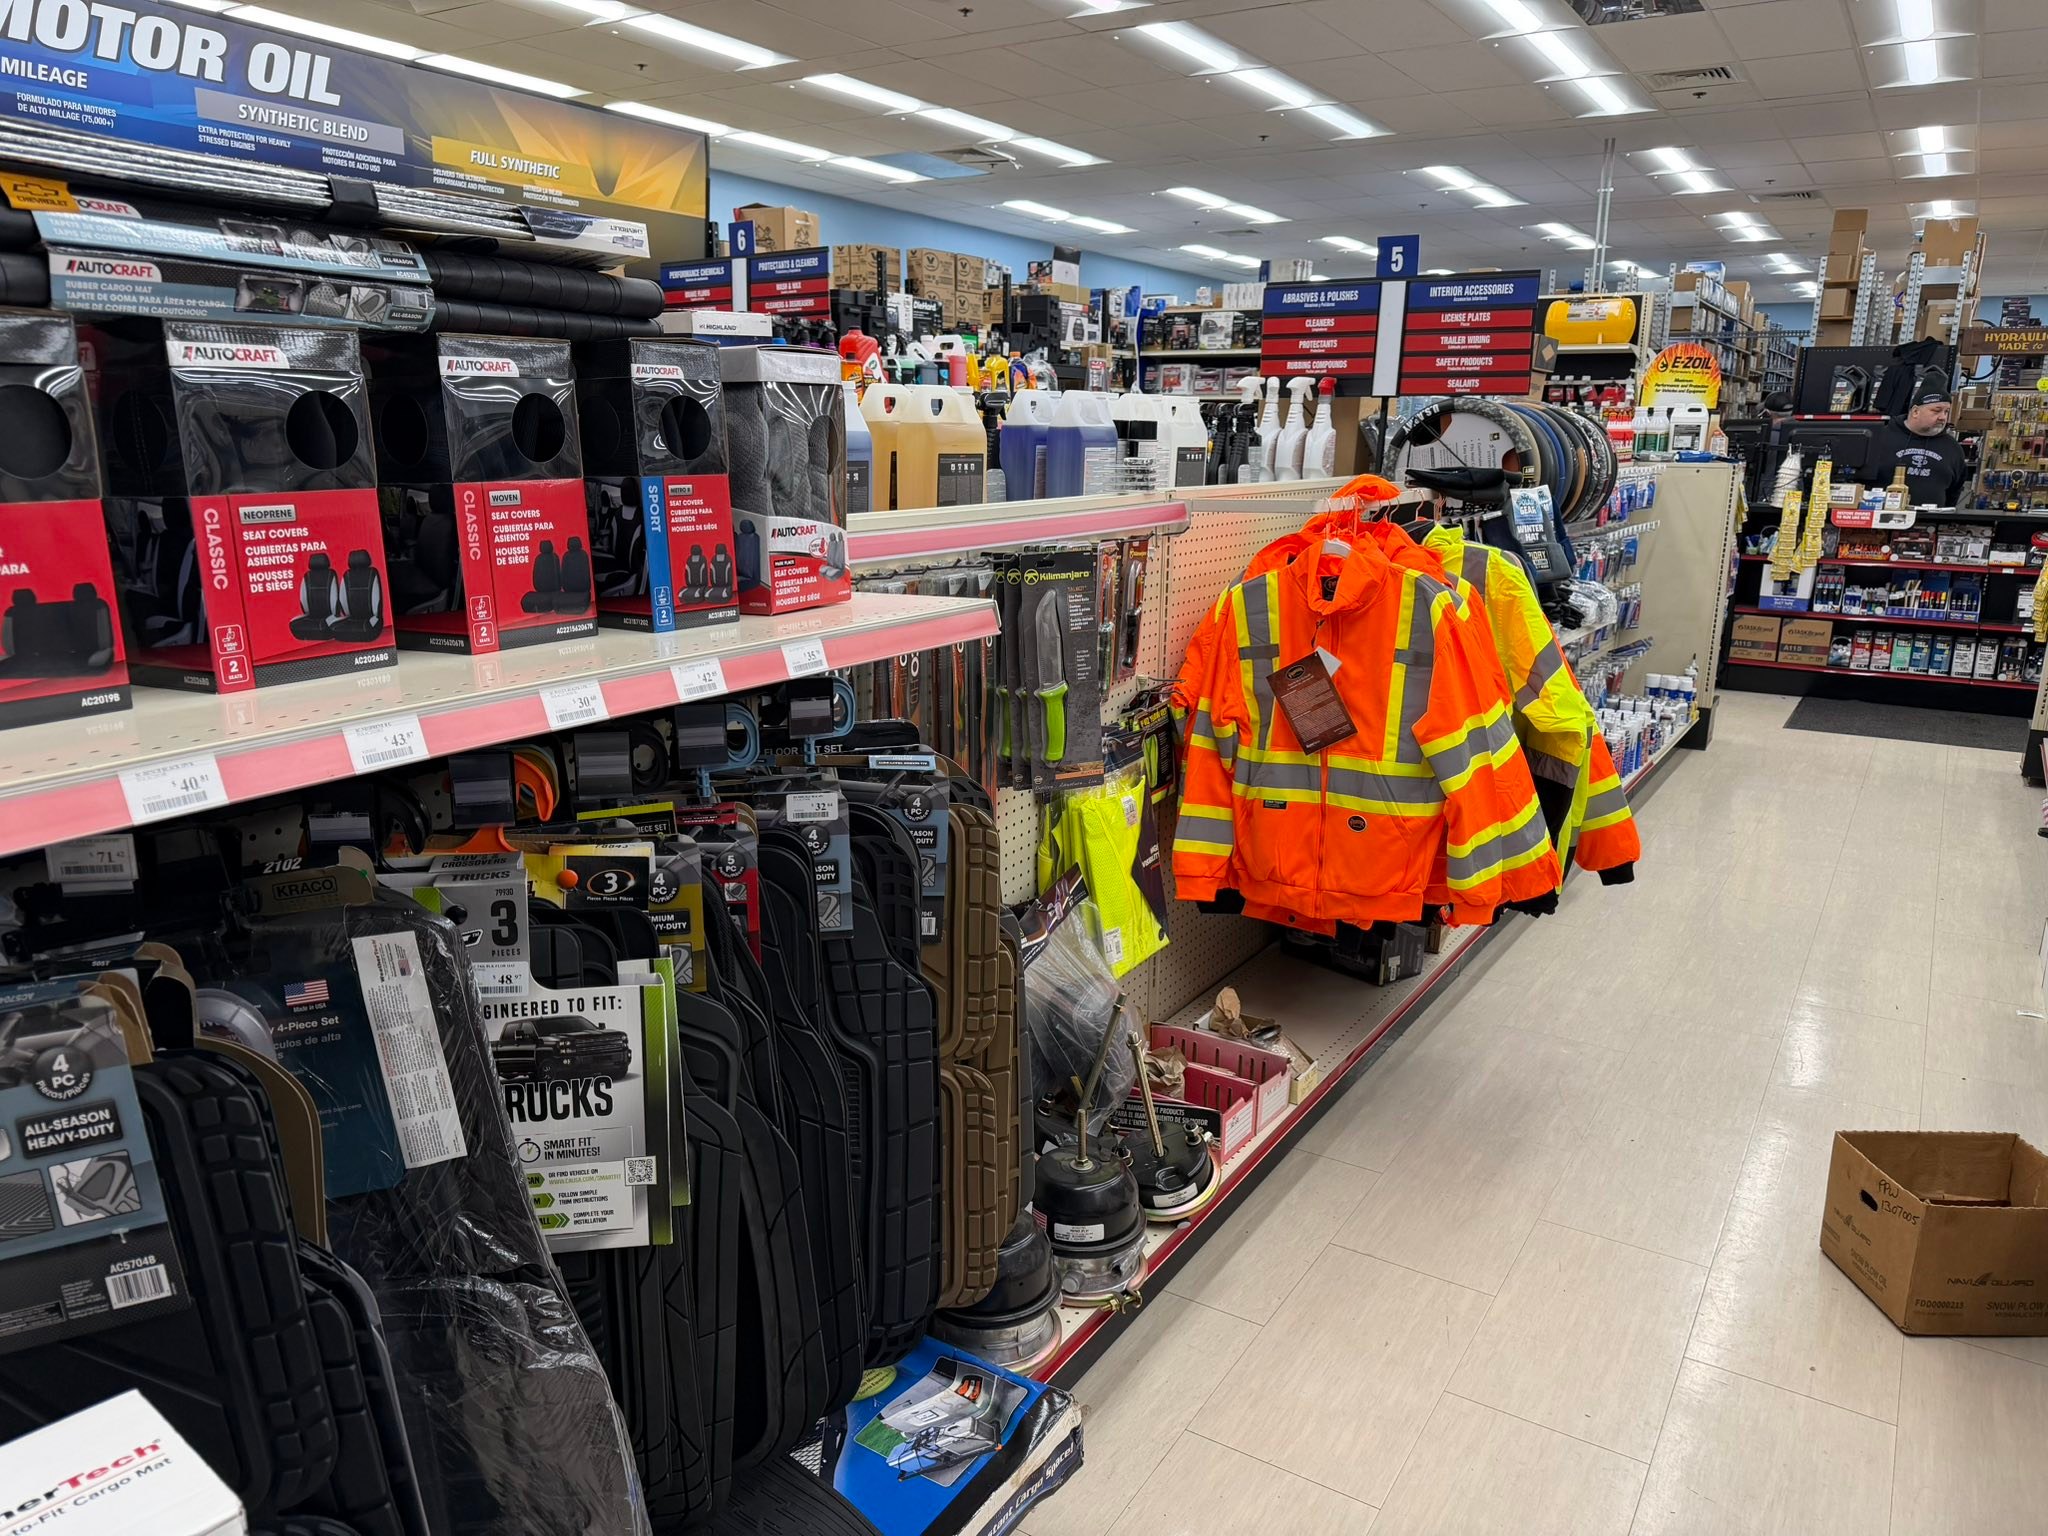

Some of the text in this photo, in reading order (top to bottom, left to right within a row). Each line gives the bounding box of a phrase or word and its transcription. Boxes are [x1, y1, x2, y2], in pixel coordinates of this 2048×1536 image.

[0, 56, 88, 90] MILEAGE
[246, 41, 340, 107] OIL
[17, 93, 117, 118] FORMULADO PARA MOTORES
[18, 103, 114, 129] DE ALTO MILLAGE (75,000+)
[239, 103, 369, 143] SYNTHETIC BLEND
[198, 126, 292, 150] EXTRA PROTECTION FOR HEAVILY
[198, 137, 229, 149] STRESSED
[470, 149, 560, 180] FULL SYNTHETIC
[738, 229, 746, 251] 6
[1391, 246, 1404, 272] 5
[78, 260, 153, 278] AUTOCRAFT
[65, 280, 153, 294] RUBBER CARGO MAT
[1430, 283, 1515, 297] INTERIOR ACCESSORIES
[66, 291, 226, 309] TAPETE DE GOMA PARA DE CARGA
[1282, 290, 1359, 304] ABRASIVES & POLISHES
[105, 304, 208, 319] COFFRE CAOUTCHOUC
[1441, 312, 1491, 323] LICENSE PLATES
[706, 323, 737, 331] HIGHLAND
[1305, 318, 1335, 328] CLEANERS
[1440, 334, 1491, 345] TRAILER WIRING
[1985, 332, 2048, 342] HYDRAULI
[1299, 340, 1338, 349] PROTECTANTS
[1998, 342, 2044, 351] MADE to
[194, 346, 277, 363] AUTOCRAFT
[454, 359, 512, 373] AUTOCRAFT
[1436, 356, 1493, 367] SAFETY PRODUCTS
[1671, 356, 1712, 369] E-ZOIL
[641, 366, 679, 376] AUTOCRAFT
[1447, 378, 1480, 388] SEALANTS
[492, 494, 518, 503] WOVEN
[682, 498, 704, 506] COVERS
[243, 509, 293, 520] NEOPRENE
[491, 509, 540, 520] SEAT COVERS
[648, 485, 661, 533] SPORT
[670, 507, 713, 517] CUBIERTAS PARA
[1520, 505, 1537, 515] GEAR
[463, 490, 481, 561] CLASSIC
[493, 522, 554, 534] CUBIERTAS PARA
[671, 525, 693, 533] HOUSSES
[777, 524, 817, 538] AUTOCRAFT
[1517, 524, 1544, 534] WINTER
[243, 527, 309, 541] SEAT COVERS
[494, 533, 530, 544] ASIENTOS
[1525, 533, 1540, 542] HAT
[204, 507, 228, 590] CLASSIC
[245, 541, 327, 556] CUBIERTAS PARA
[495, 546, 530, 557] HOUSSES
[247, 555, 295, 568] ASIENTOS
[496, 554, 529, 566] DE SIÈGE
[249, 569, 294, 582] HOUSSES
[774, 566, 809, 578] SEAT COVERS
[1040, 570, 1089, 582] Kilimanjaro
[251, 579, 294, 593] DE SIÈGE
[803, 576, 817, 584] PARA
[661, 610, 667, 619] 2
[481, 626, 488, 636] 2
[354, 652, 389, 666] AC2026BG
[230, 661, 239, 673] 2
[81, 693, 121, 708] AC2019B
[764, 744, 843, 756] FLOOR SET
[911, 807, 922, 815] PC
[655, 823, 667, 832] SET
[441, 857, 507, 869] CROSSOVERS
[725, 865, 737, 873] PC
[450, 870, 511, 883] TRUCKS
[604, 872, 618, 893] 3
[654, 872, 664, 886] 4
[275, 878, 334, 900] KRACO
[653, 886, 667, 896] PC
[490, 899, 519, 947] 3
[491, 949, 521, 959] PIECES
[293, 1003, 326, 1014] Made USA
[483, 995, 623, 1020] GINEERED TO FIT:
[277, 1015, 340, 1034] 4-Piece Set
[304, 1032, 342, 1047] de alta
[52, 1054, 70, 1073] 4
[52, 1073, 76, 1090] PC
[504, 1075, 613, 1124] RUCKS
[25, 1108, 111, 1137] ALL-SEASON
[27, 1122, 116, 1151] HEAVY-DUTY
[544, 1138, 592, 1152] SMART FIT
[545, 1147, 601, 1161] IN MINUTES!
[556, 1170, 568, 1178] FIND
[558, 1189, 598, 1199] FOLLOW SIMPLE
[559, 1195, 609, 1206] TRIM INSTRUCTIONS
[573, 1209, 615, 1220] COMPLETE YOUR
[574, 1216, 608, 1226] INSTALLATION
[110, 1254, 156, 1275] AC5704B
[1015, 1441, 1075, 1509] Cargo Space!
[73, 1457, 173, 1507] Cargo Mat
